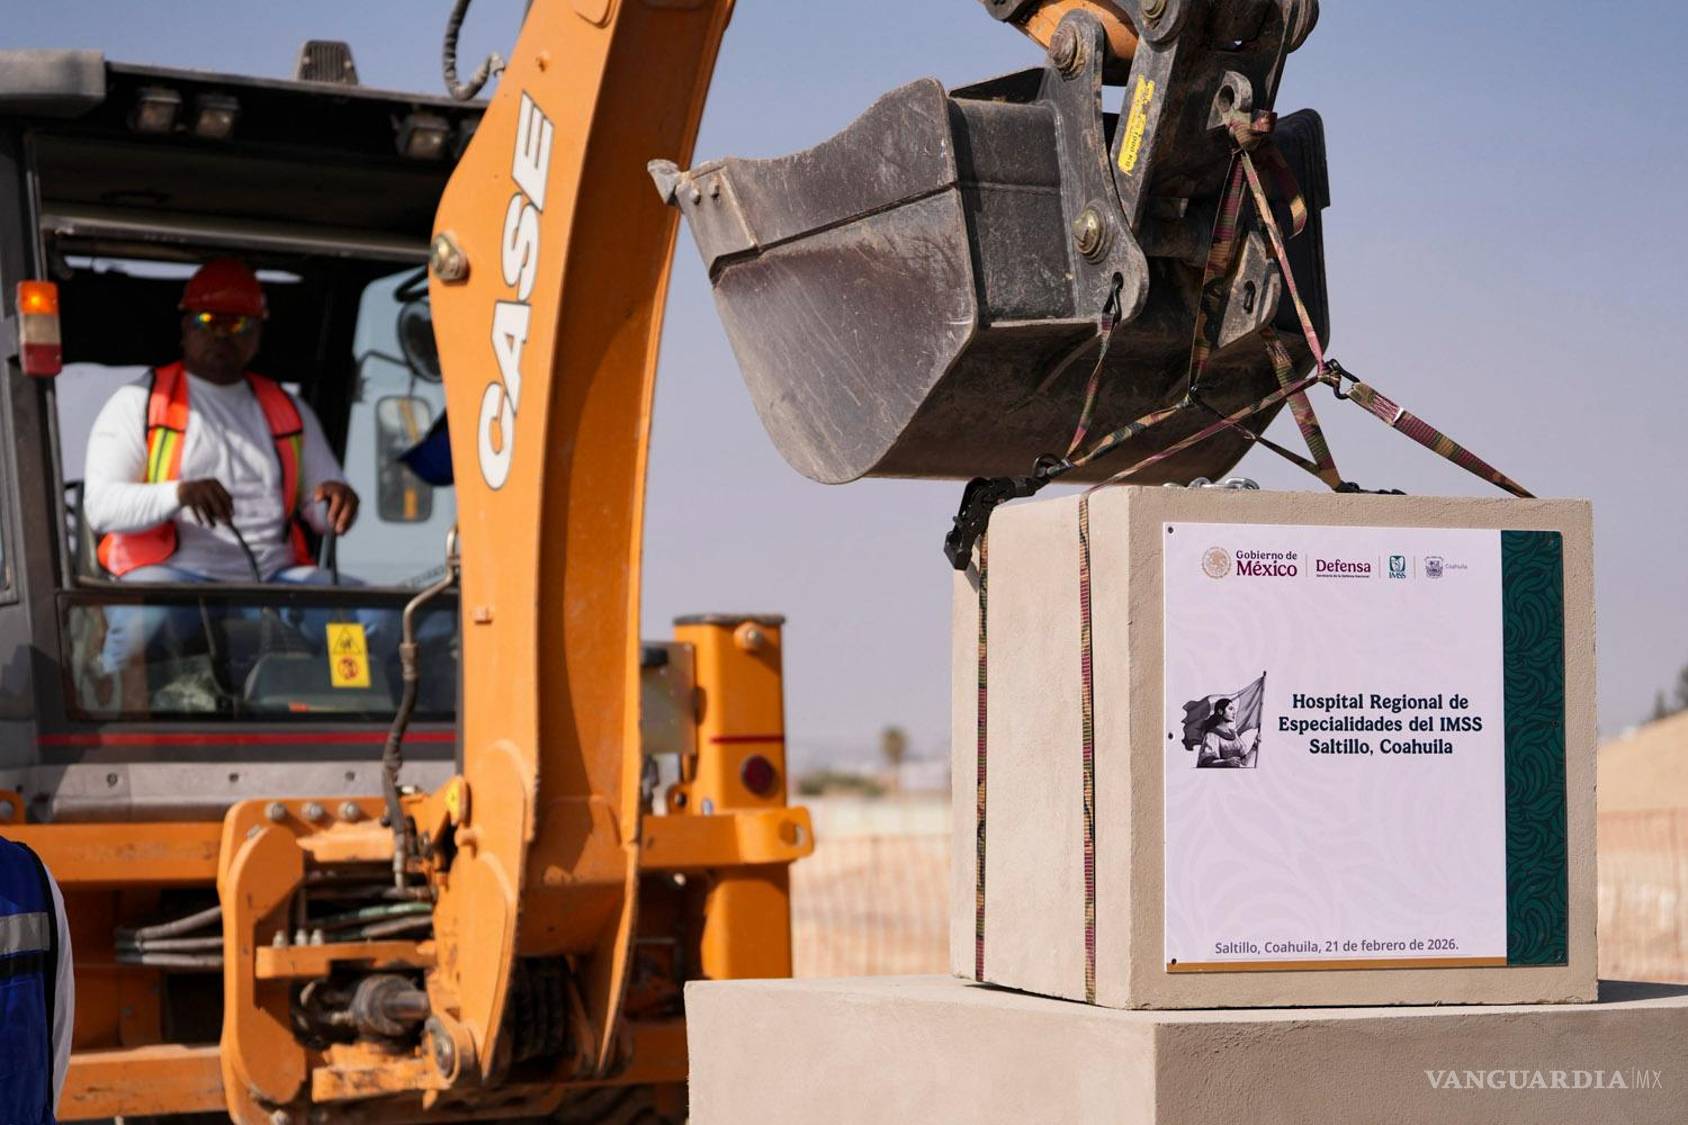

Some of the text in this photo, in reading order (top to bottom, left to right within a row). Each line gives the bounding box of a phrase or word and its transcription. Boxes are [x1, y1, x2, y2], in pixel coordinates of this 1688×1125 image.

[477, 90, 555, 491] CASE
[1236, 550, 1298, 560] Gobierno de
[1236, 560, 1298, 577] México
[1316, 558, 1371, 573] Defensa
[1292, 693, 1469, 714] Hospital Regional de
[1278, 715, 1483, 736] Especialidades del IMSS
[1309, 738, 1453, 756] Saltillo, Coahuila
[1215, 938, 1459, 955] Saltillo, Coahuila, 21 de febrero de 2026.
